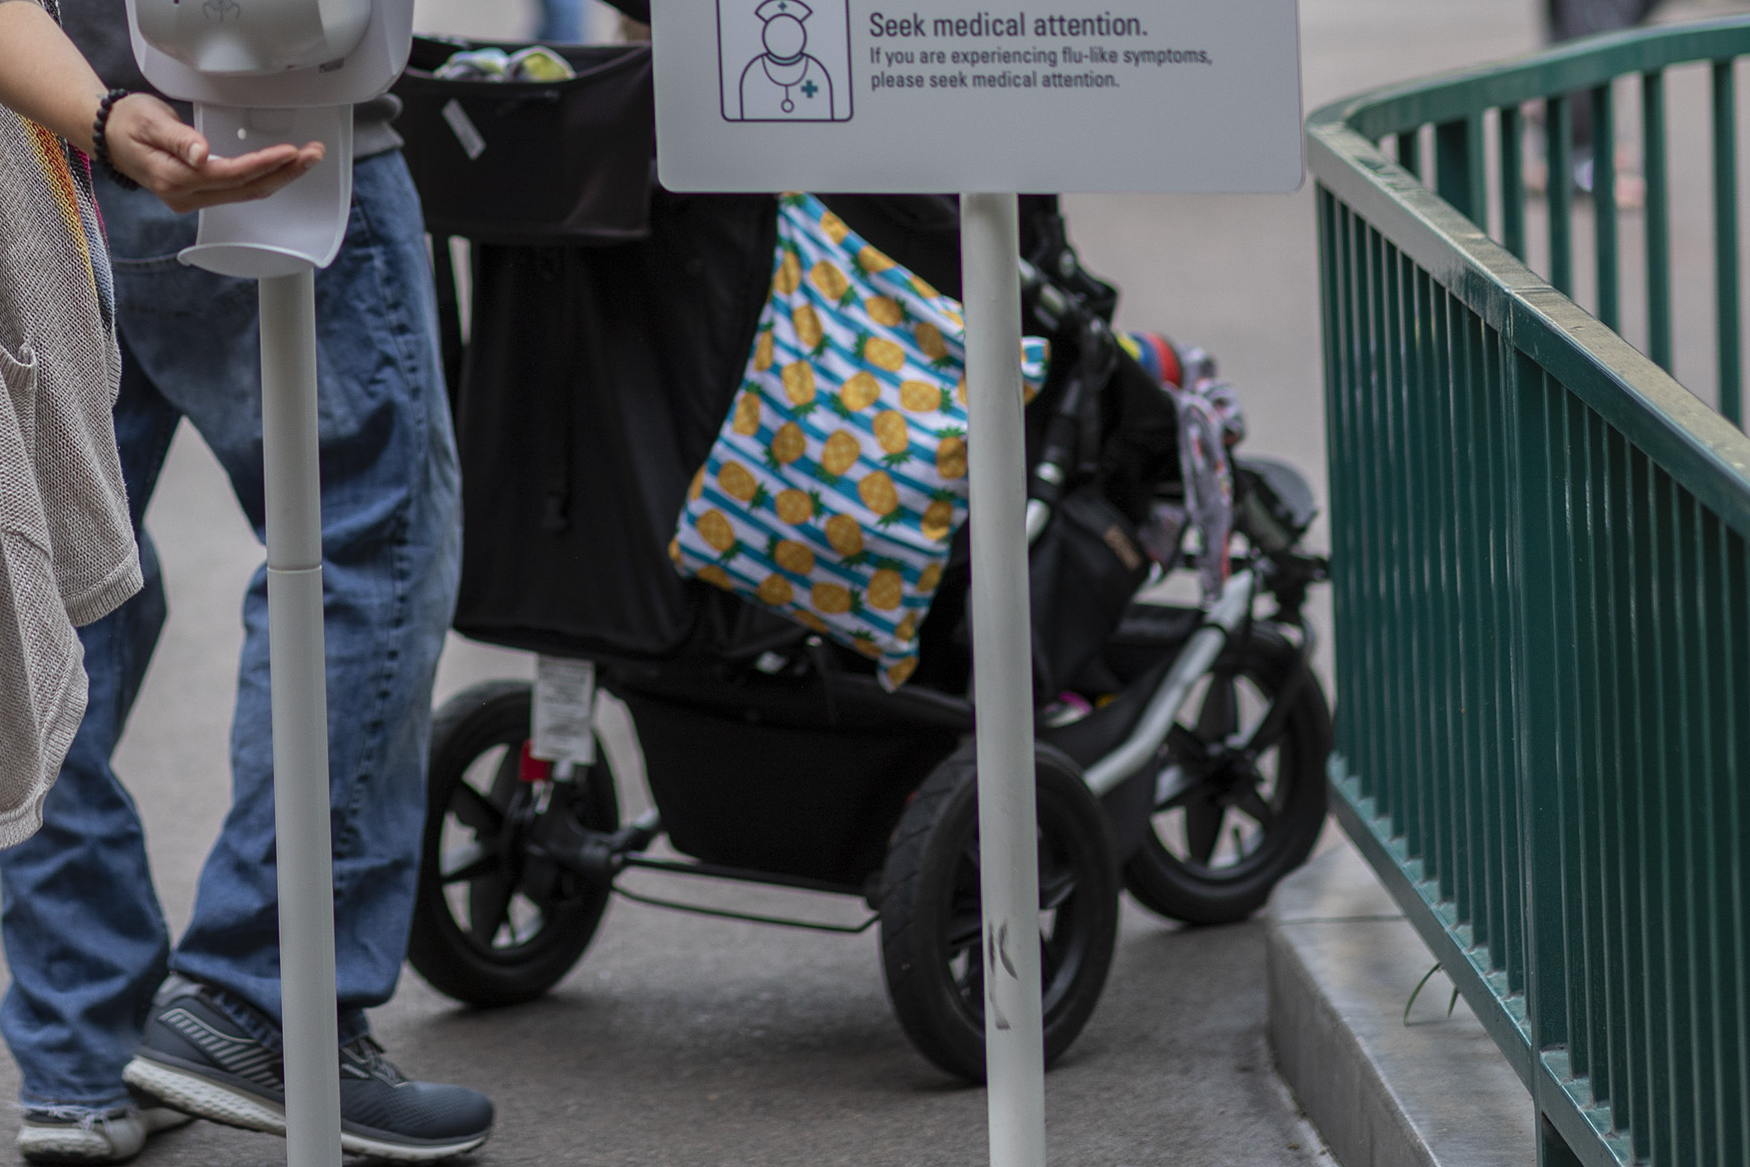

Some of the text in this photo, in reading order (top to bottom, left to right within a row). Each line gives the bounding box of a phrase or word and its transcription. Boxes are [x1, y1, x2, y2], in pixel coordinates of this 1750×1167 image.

[869, 11, 1147, 37] Seek medical attention.
[871, 47, 1212, 67] If you are experiencing flu-like symptoms,
[871, 71, 1120, 91] please seek medical attention.
